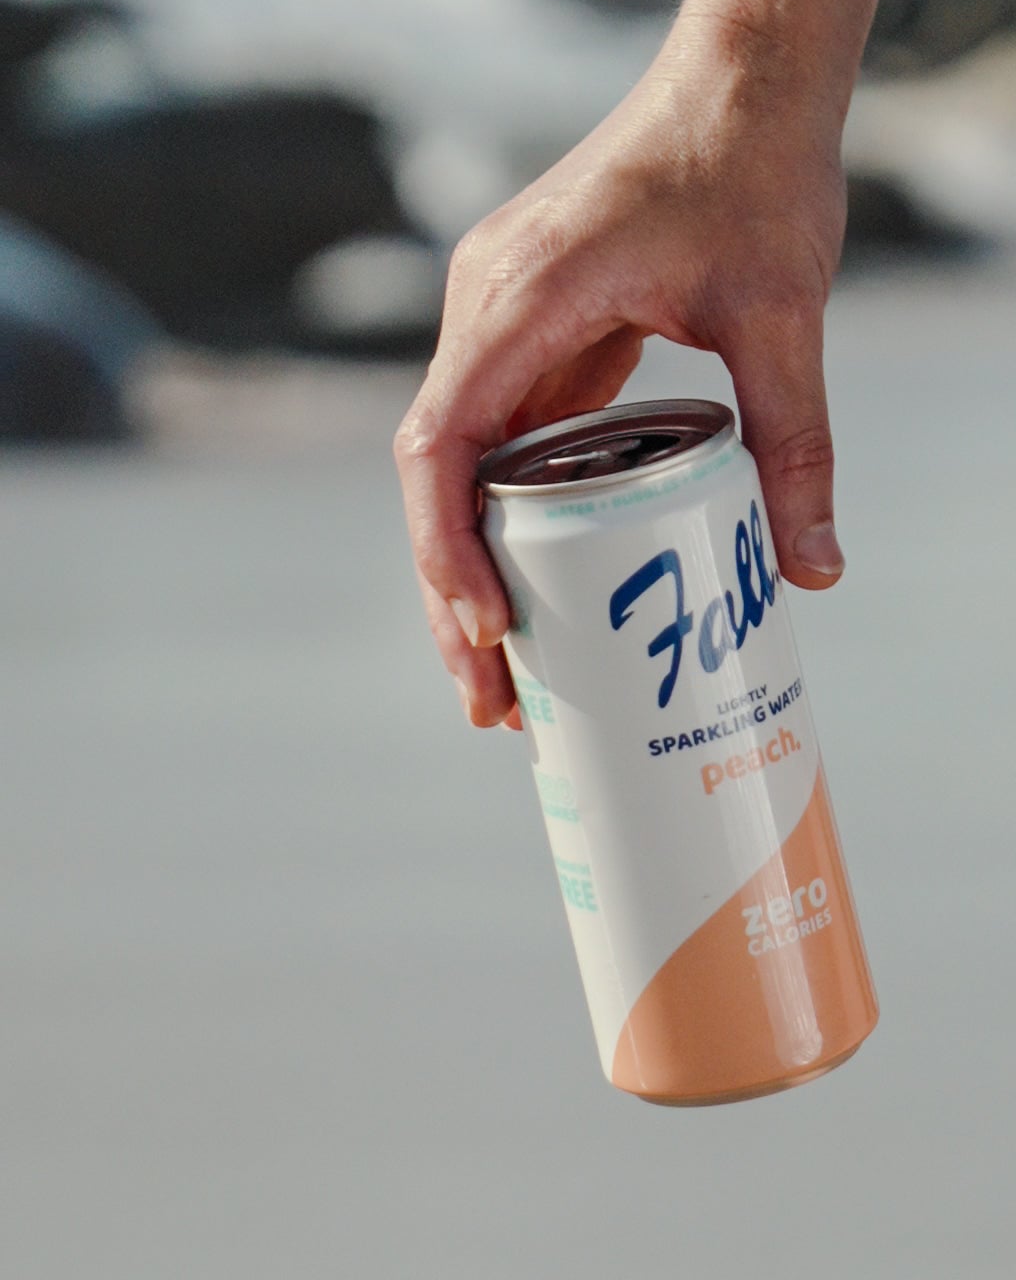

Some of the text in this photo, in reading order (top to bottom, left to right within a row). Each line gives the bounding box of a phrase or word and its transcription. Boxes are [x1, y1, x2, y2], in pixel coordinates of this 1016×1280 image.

[717, 683, 767, 715] LIGHTLY
[648, 705, 766, 757] SPARKLING
[701, 725, 801, 795] peach.
[742, 878, 827, 937] zero
[748, 907, 832, 956] CALORIES
